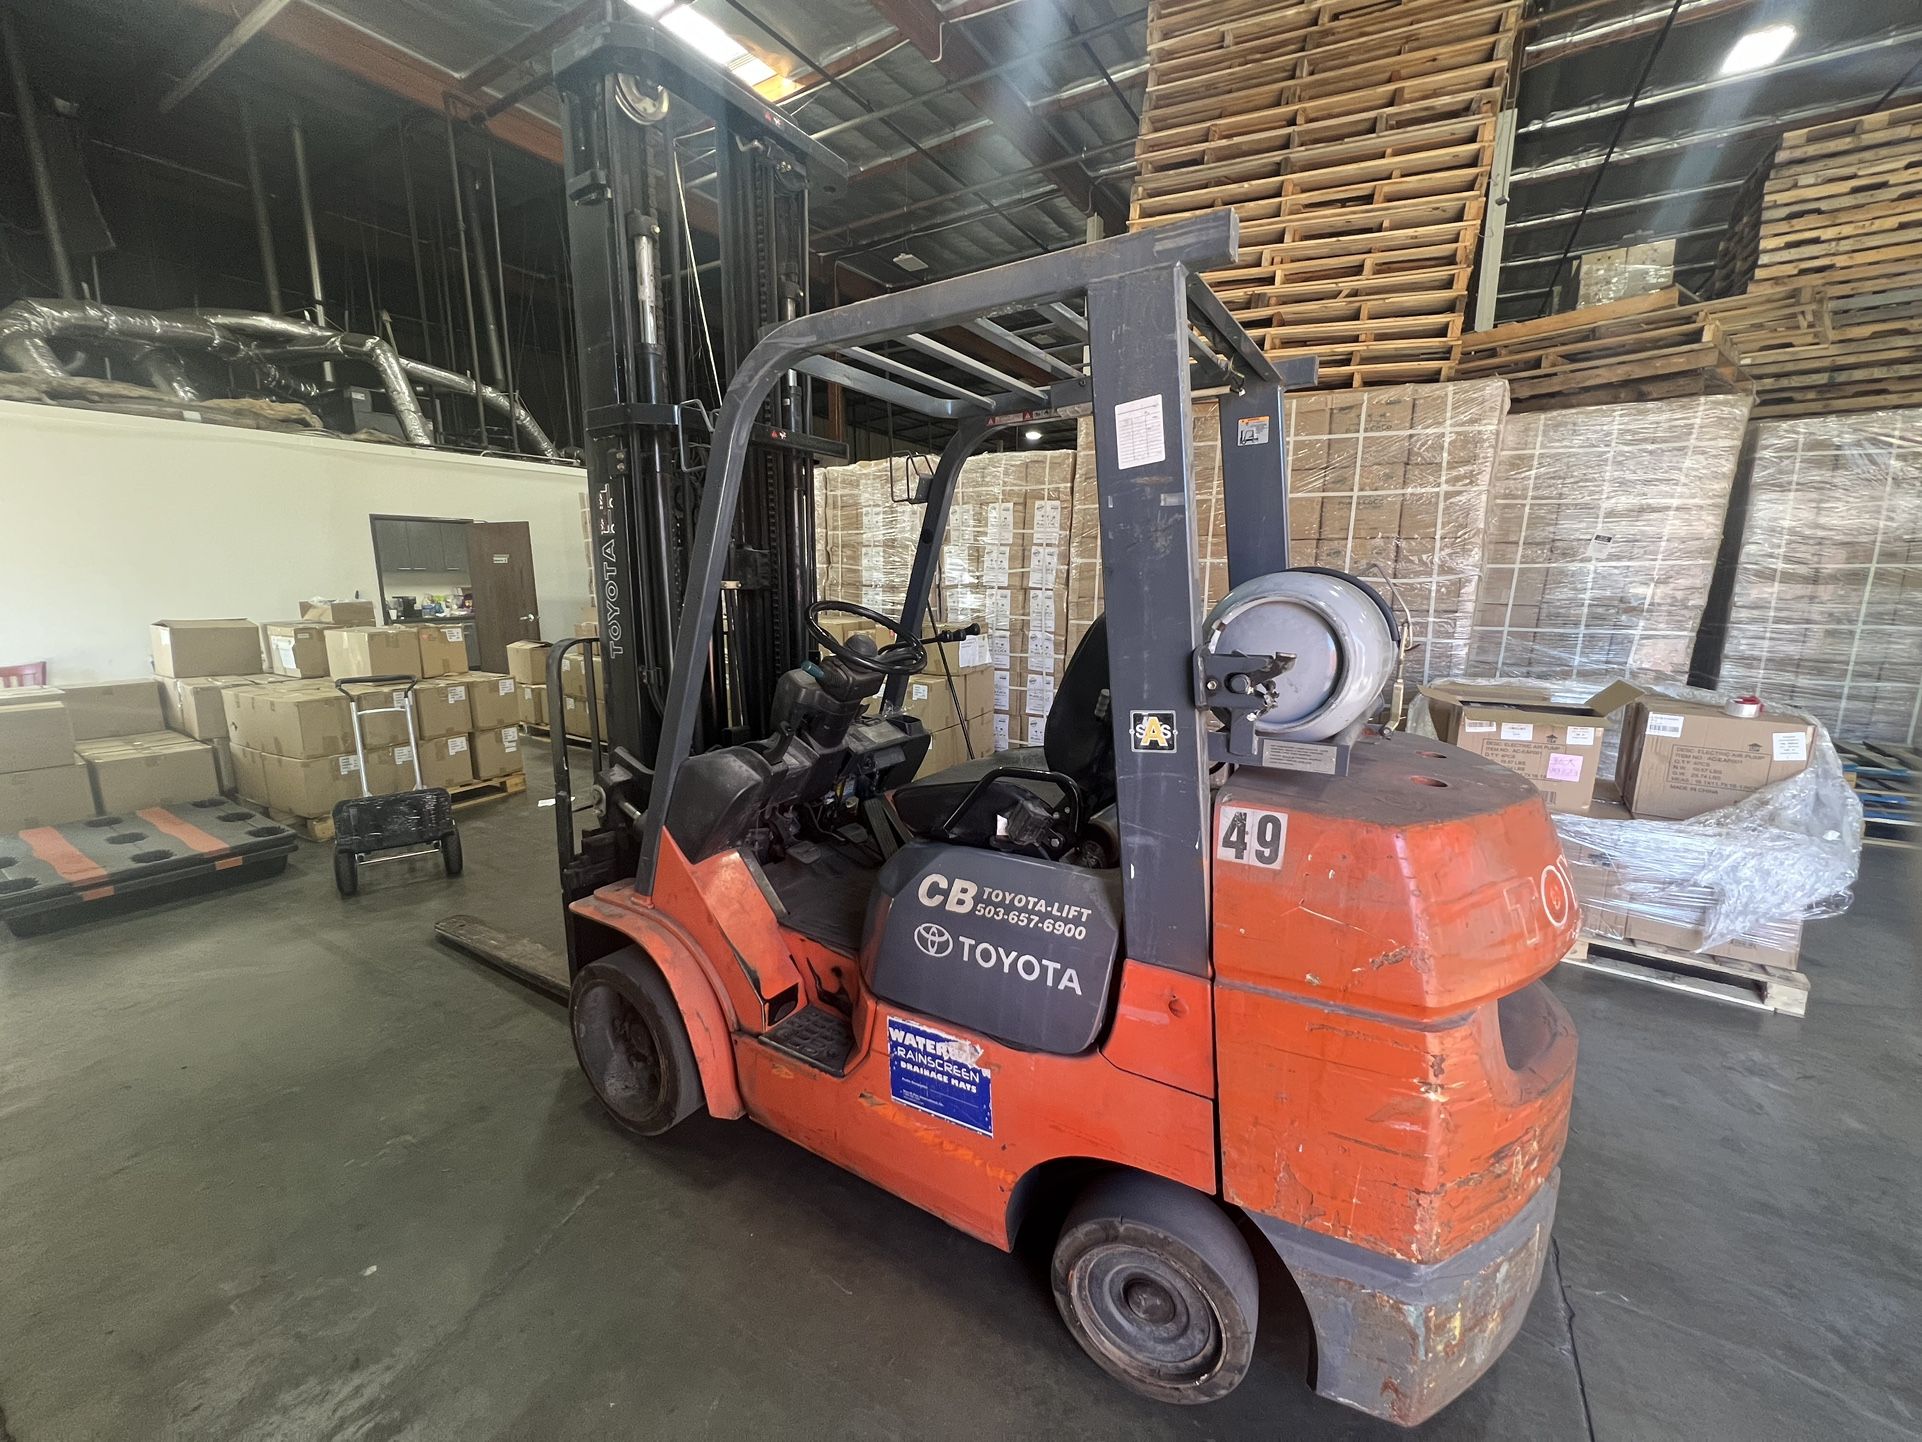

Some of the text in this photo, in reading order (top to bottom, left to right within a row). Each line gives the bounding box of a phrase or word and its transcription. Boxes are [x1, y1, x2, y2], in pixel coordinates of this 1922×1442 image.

[602, 538, 624, 660] TOYOTA
[1222, 812, 1282, 865] 49
[918, 873, 978, 914] CB
[982, 887, 1092, 922] TOYOTA-LIFT
[958, 936, 1082, 996] TOYOTA
[897, 1047, 980, 1083] RAINSCREEN
[900, 1061, 949, 1083] DRAINAGE
[951, 1079, 977, 1094] MATS
